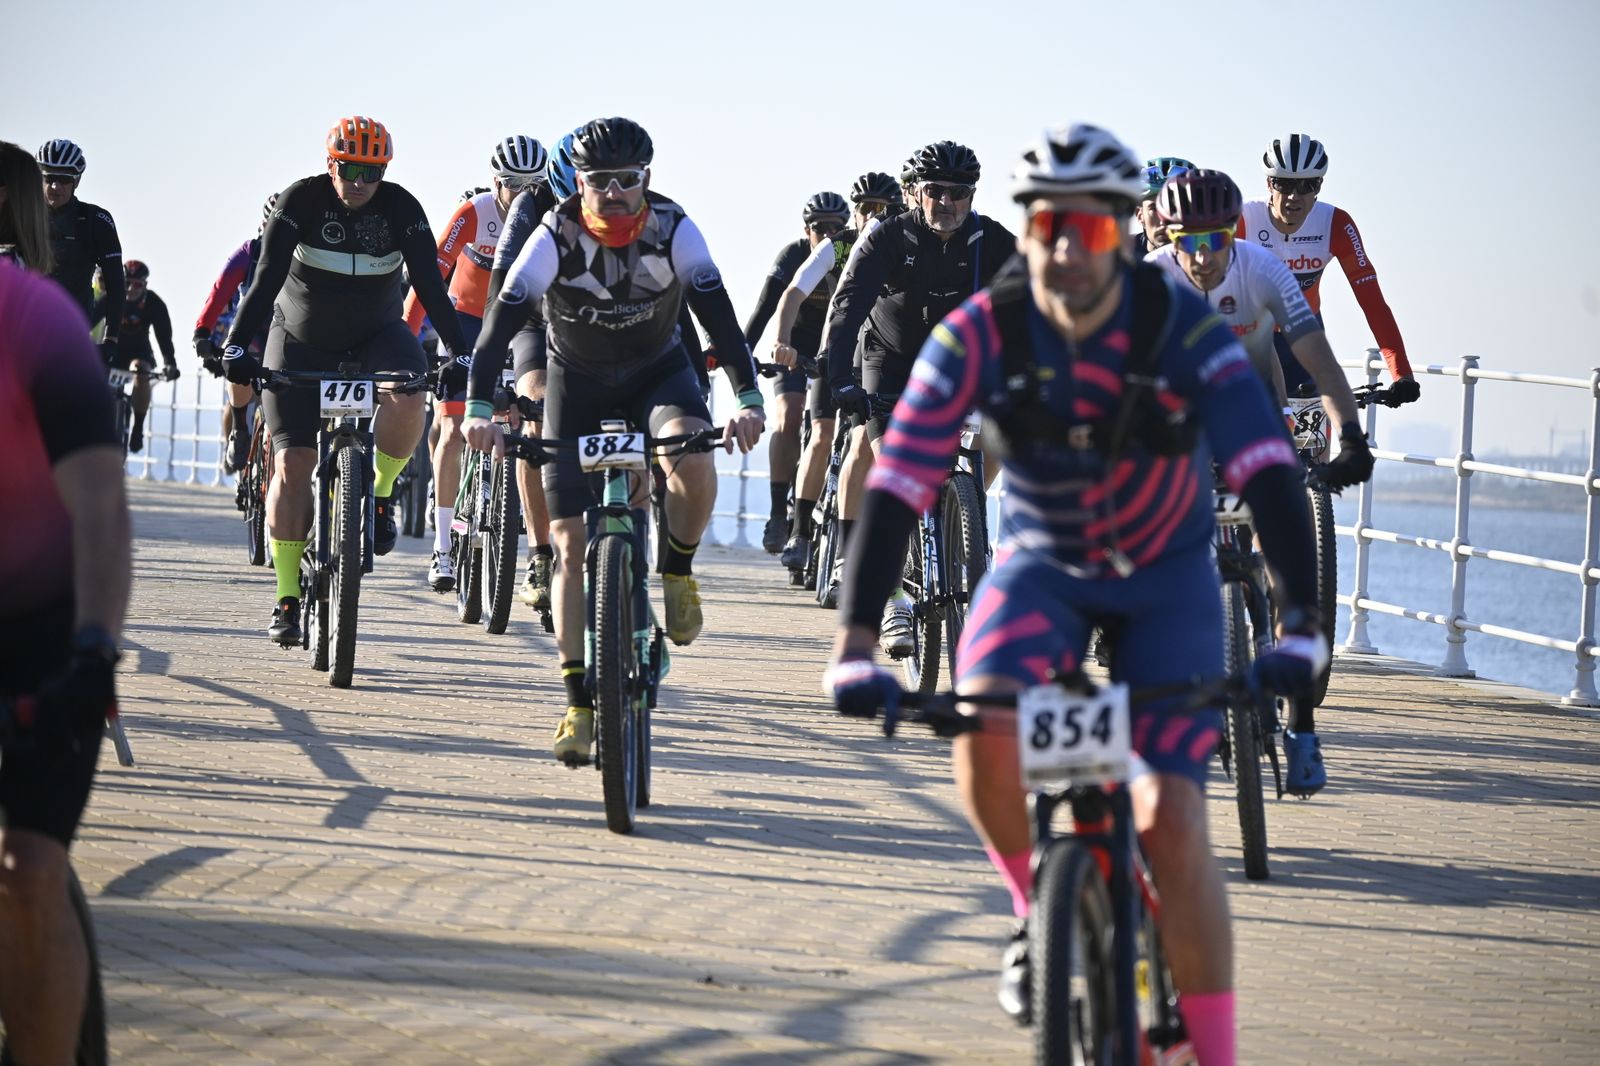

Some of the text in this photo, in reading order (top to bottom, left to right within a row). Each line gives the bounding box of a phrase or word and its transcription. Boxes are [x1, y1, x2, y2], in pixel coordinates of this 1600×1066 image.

[443, 216, 466, 253] romacho
[1292, 234, 1324, 242] TREK
[1344, 223, 1366, 267] romacho
[1284, 254, 1323, 271] acho
[324, 382, 366, 402] 476
[1294, 410, 1322, 436] 58
[584, 434, 636, 458] 882
[1030, 704, 1113, 752] 854
